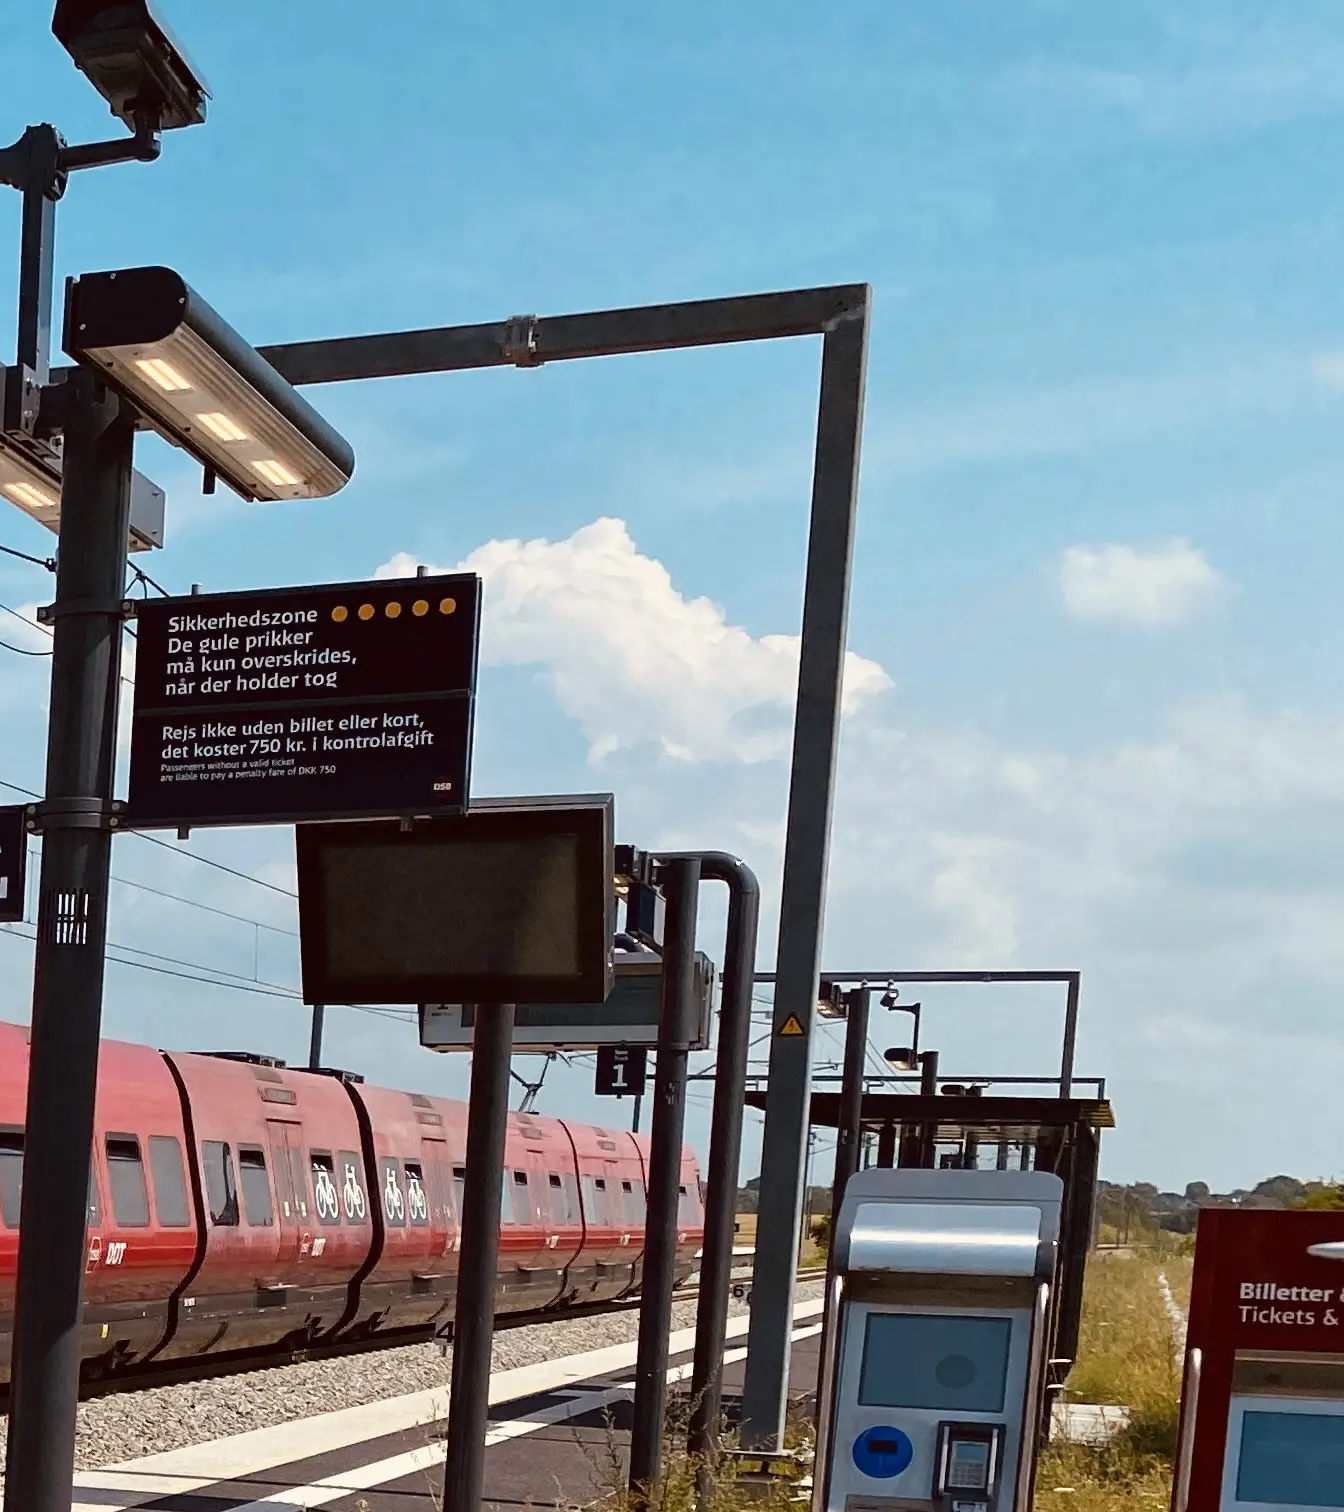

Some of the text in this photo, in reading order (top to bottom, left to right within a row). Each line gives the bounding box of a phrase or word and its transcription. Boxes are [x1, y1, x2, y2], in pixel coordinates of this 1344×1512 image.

[168, 610, 318, 632] Sikkerhedszone
[168, 630, 313, 654] De gule prikker
[166, 648, 357, 674] må kun overskrides,
[165, 671, 338, 695] når der holder tog
[162, 713, 424, 742] Rejs ikke uden billet eller kort,
[162, 730, 434, 759] det koster 750 kr. i kontrolafgift
[200, 772, 209, 780] to
[211, 772, 226, 780] pay
[269, 768, 285, 777] fare
[287, 767, 296, 776] of
[298, 765, 317, 775] DKK
[319, 765, 336, 773] 750
[208, 761, 239, 770] without
[612, 1064, 627, 1086] 1
[733, 1284, 744, 1298] 6
[1240, 1283, 1334, 1302] Billetter
[1238, 1305, 1339, 1325] Tickets &
[436, 1321, 455, 1343] 4
